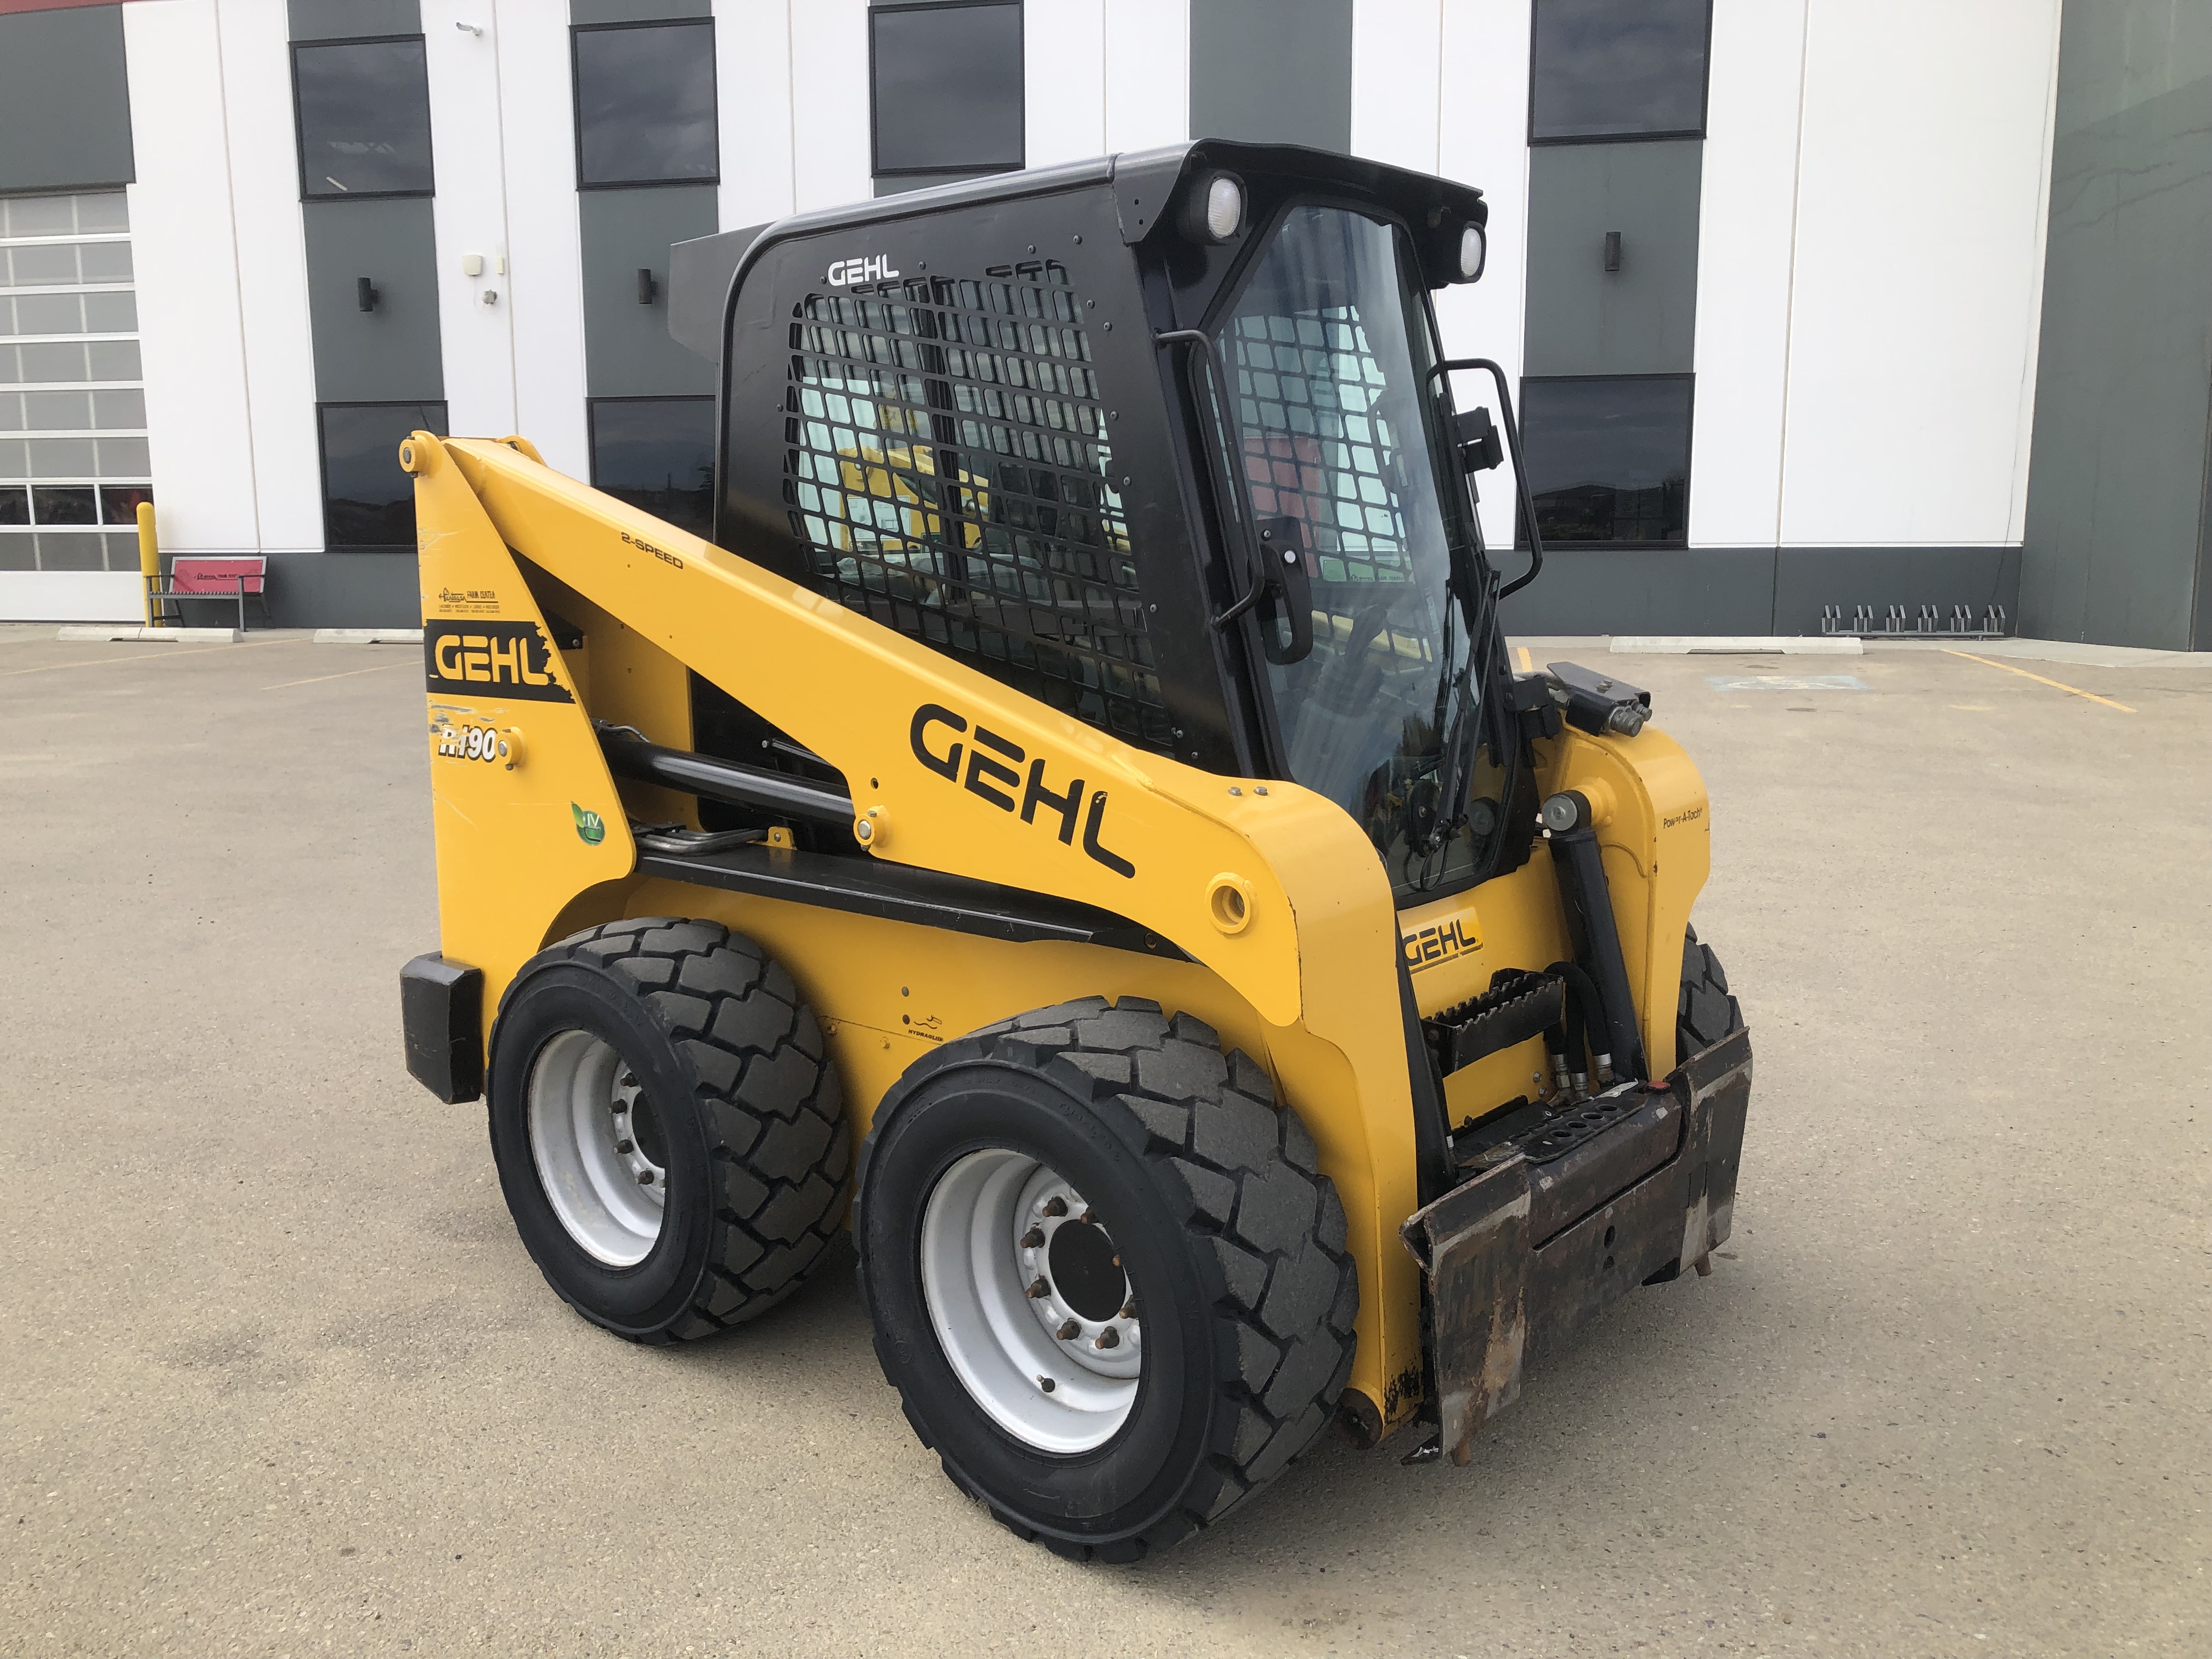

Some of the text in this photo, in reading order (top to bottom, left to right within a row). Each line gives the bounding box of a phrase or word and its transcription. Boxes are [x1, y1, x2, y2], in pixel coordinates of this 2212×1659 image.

[828, 253, 899, 286] GEHL
[620, 532, 684, 569] 2-SPEED
[435, 635, 549, 686] GEHL
[910, 704, 1136, 879] GEHL
[1403, 919, 1476, 967] GEHL
